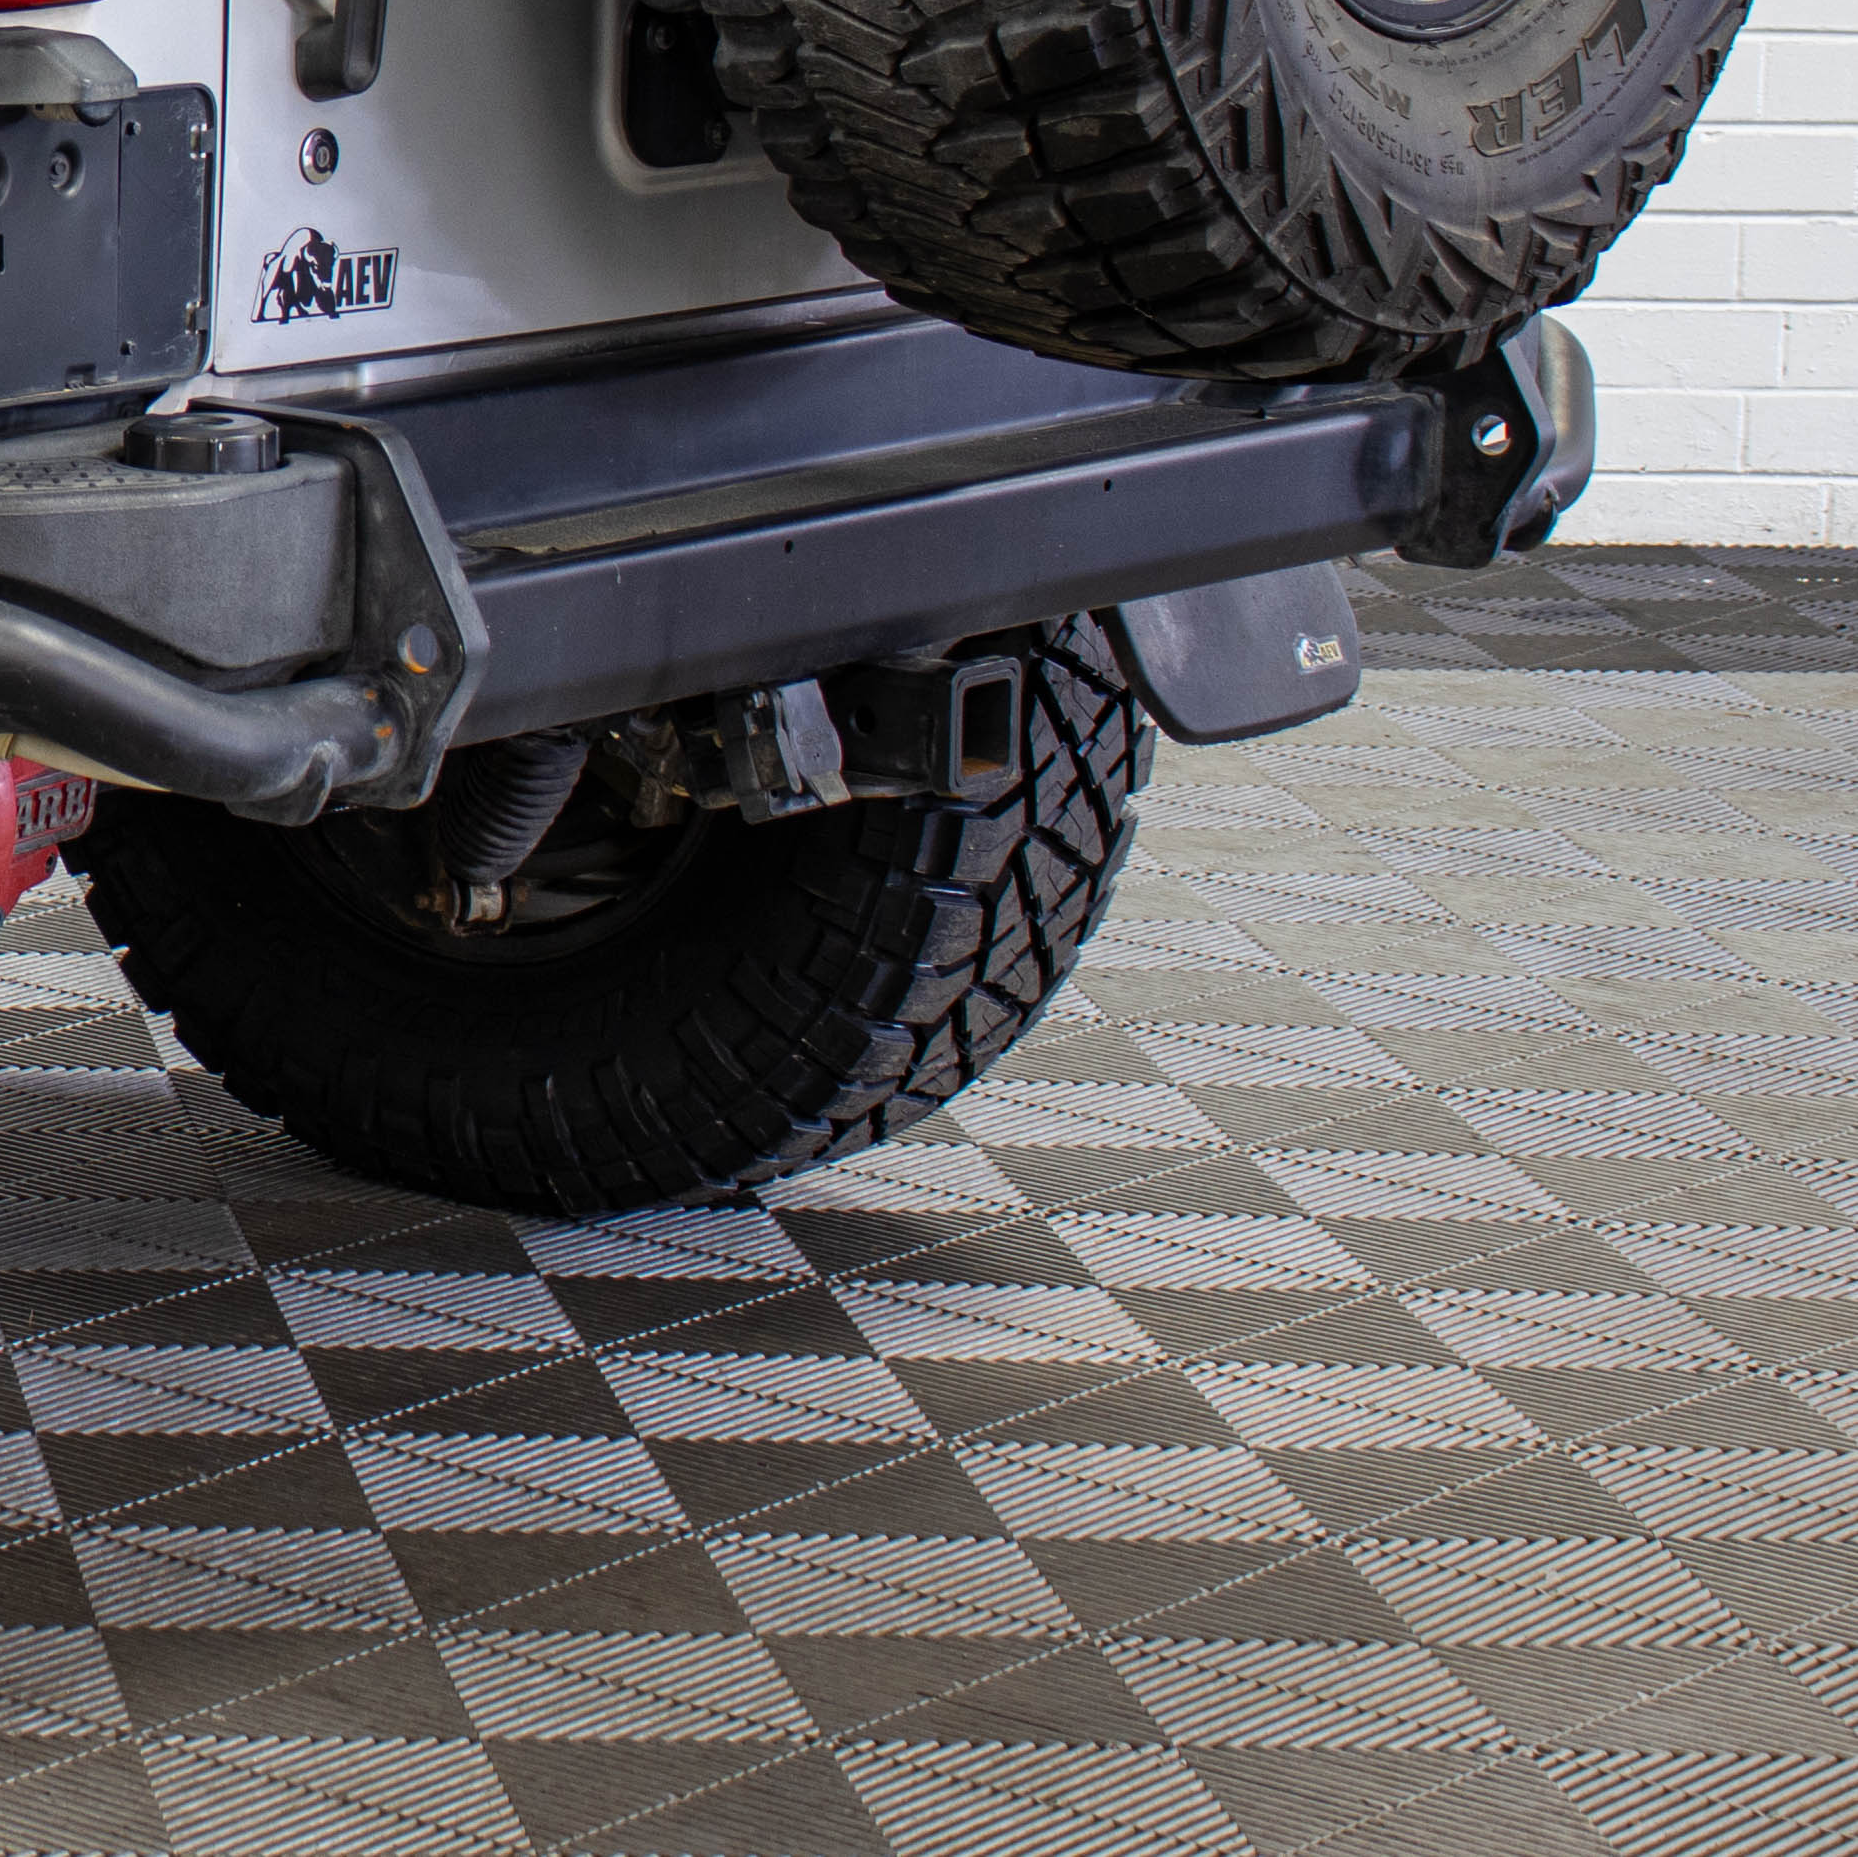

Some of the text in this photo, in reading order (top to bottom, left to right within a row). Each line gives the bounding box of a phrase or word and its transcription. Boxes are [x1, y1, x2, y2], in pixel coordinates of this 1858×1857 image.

[335, 253, 393, 307] AEV
[1319, 642, 1339, 660] AEV
[16, 779, 87, 840] ARB
